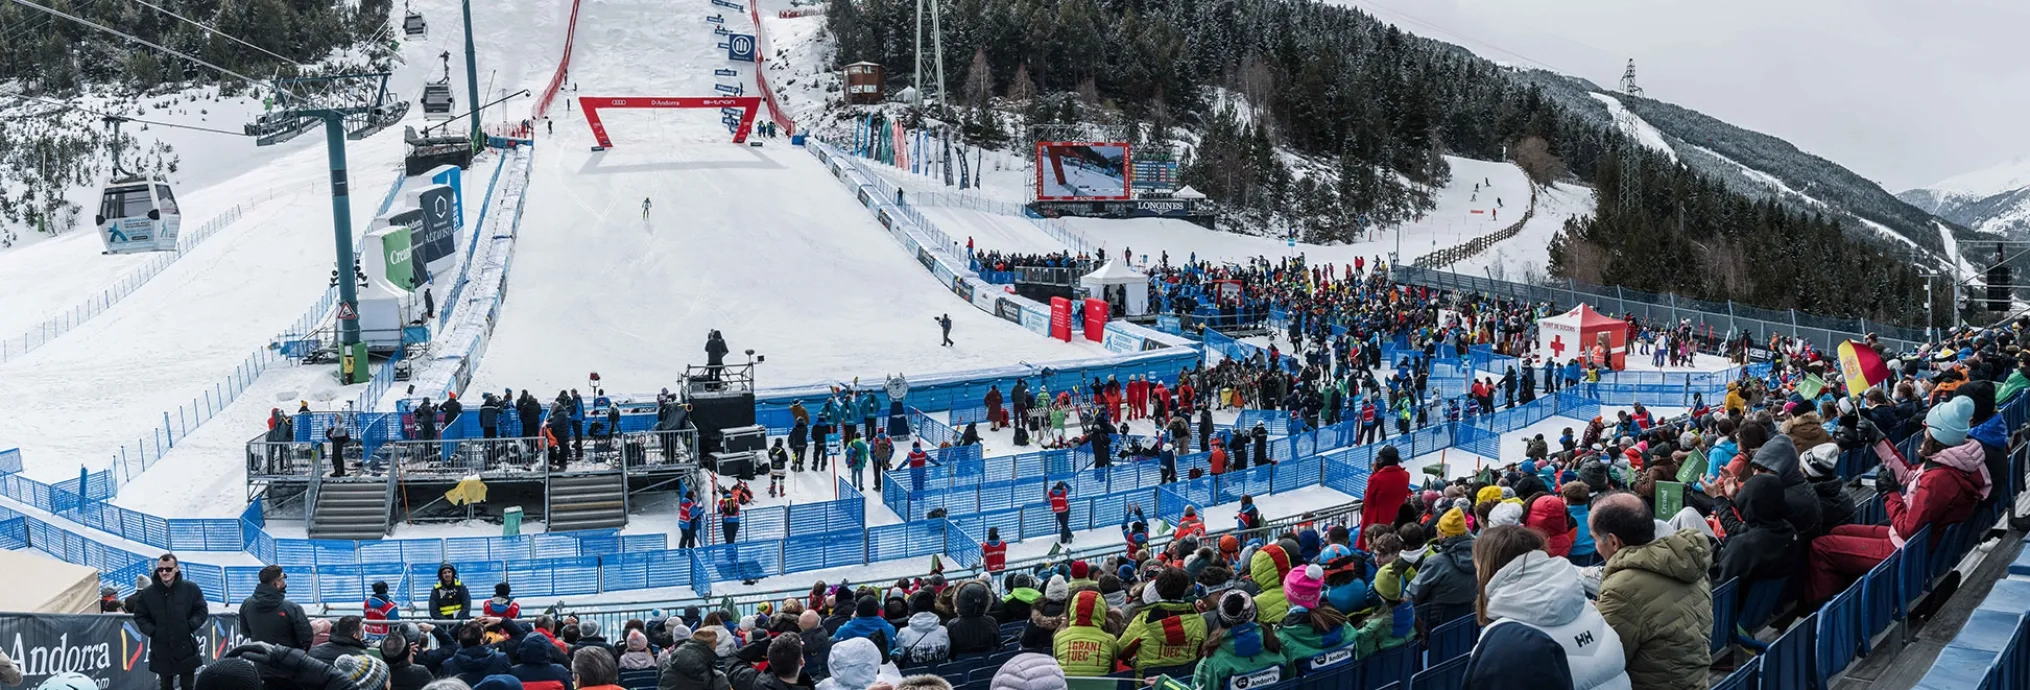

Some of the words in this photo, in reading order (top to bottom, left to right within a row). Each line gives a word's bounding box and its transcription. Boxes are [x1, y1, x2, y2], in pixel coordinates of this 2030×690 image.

[1138, 201, 1184, 210] LONGINES
[1560, 324, 1575, 332] SOCORS
[1574, 630, 1594, 648] HH
[1072, 641, 1097, 652] GRAN
[1163, 646, 1181, 657] UEC
[10, 632, 111, 675] Andorra
[1072, 651, 1089, 661] UEC
